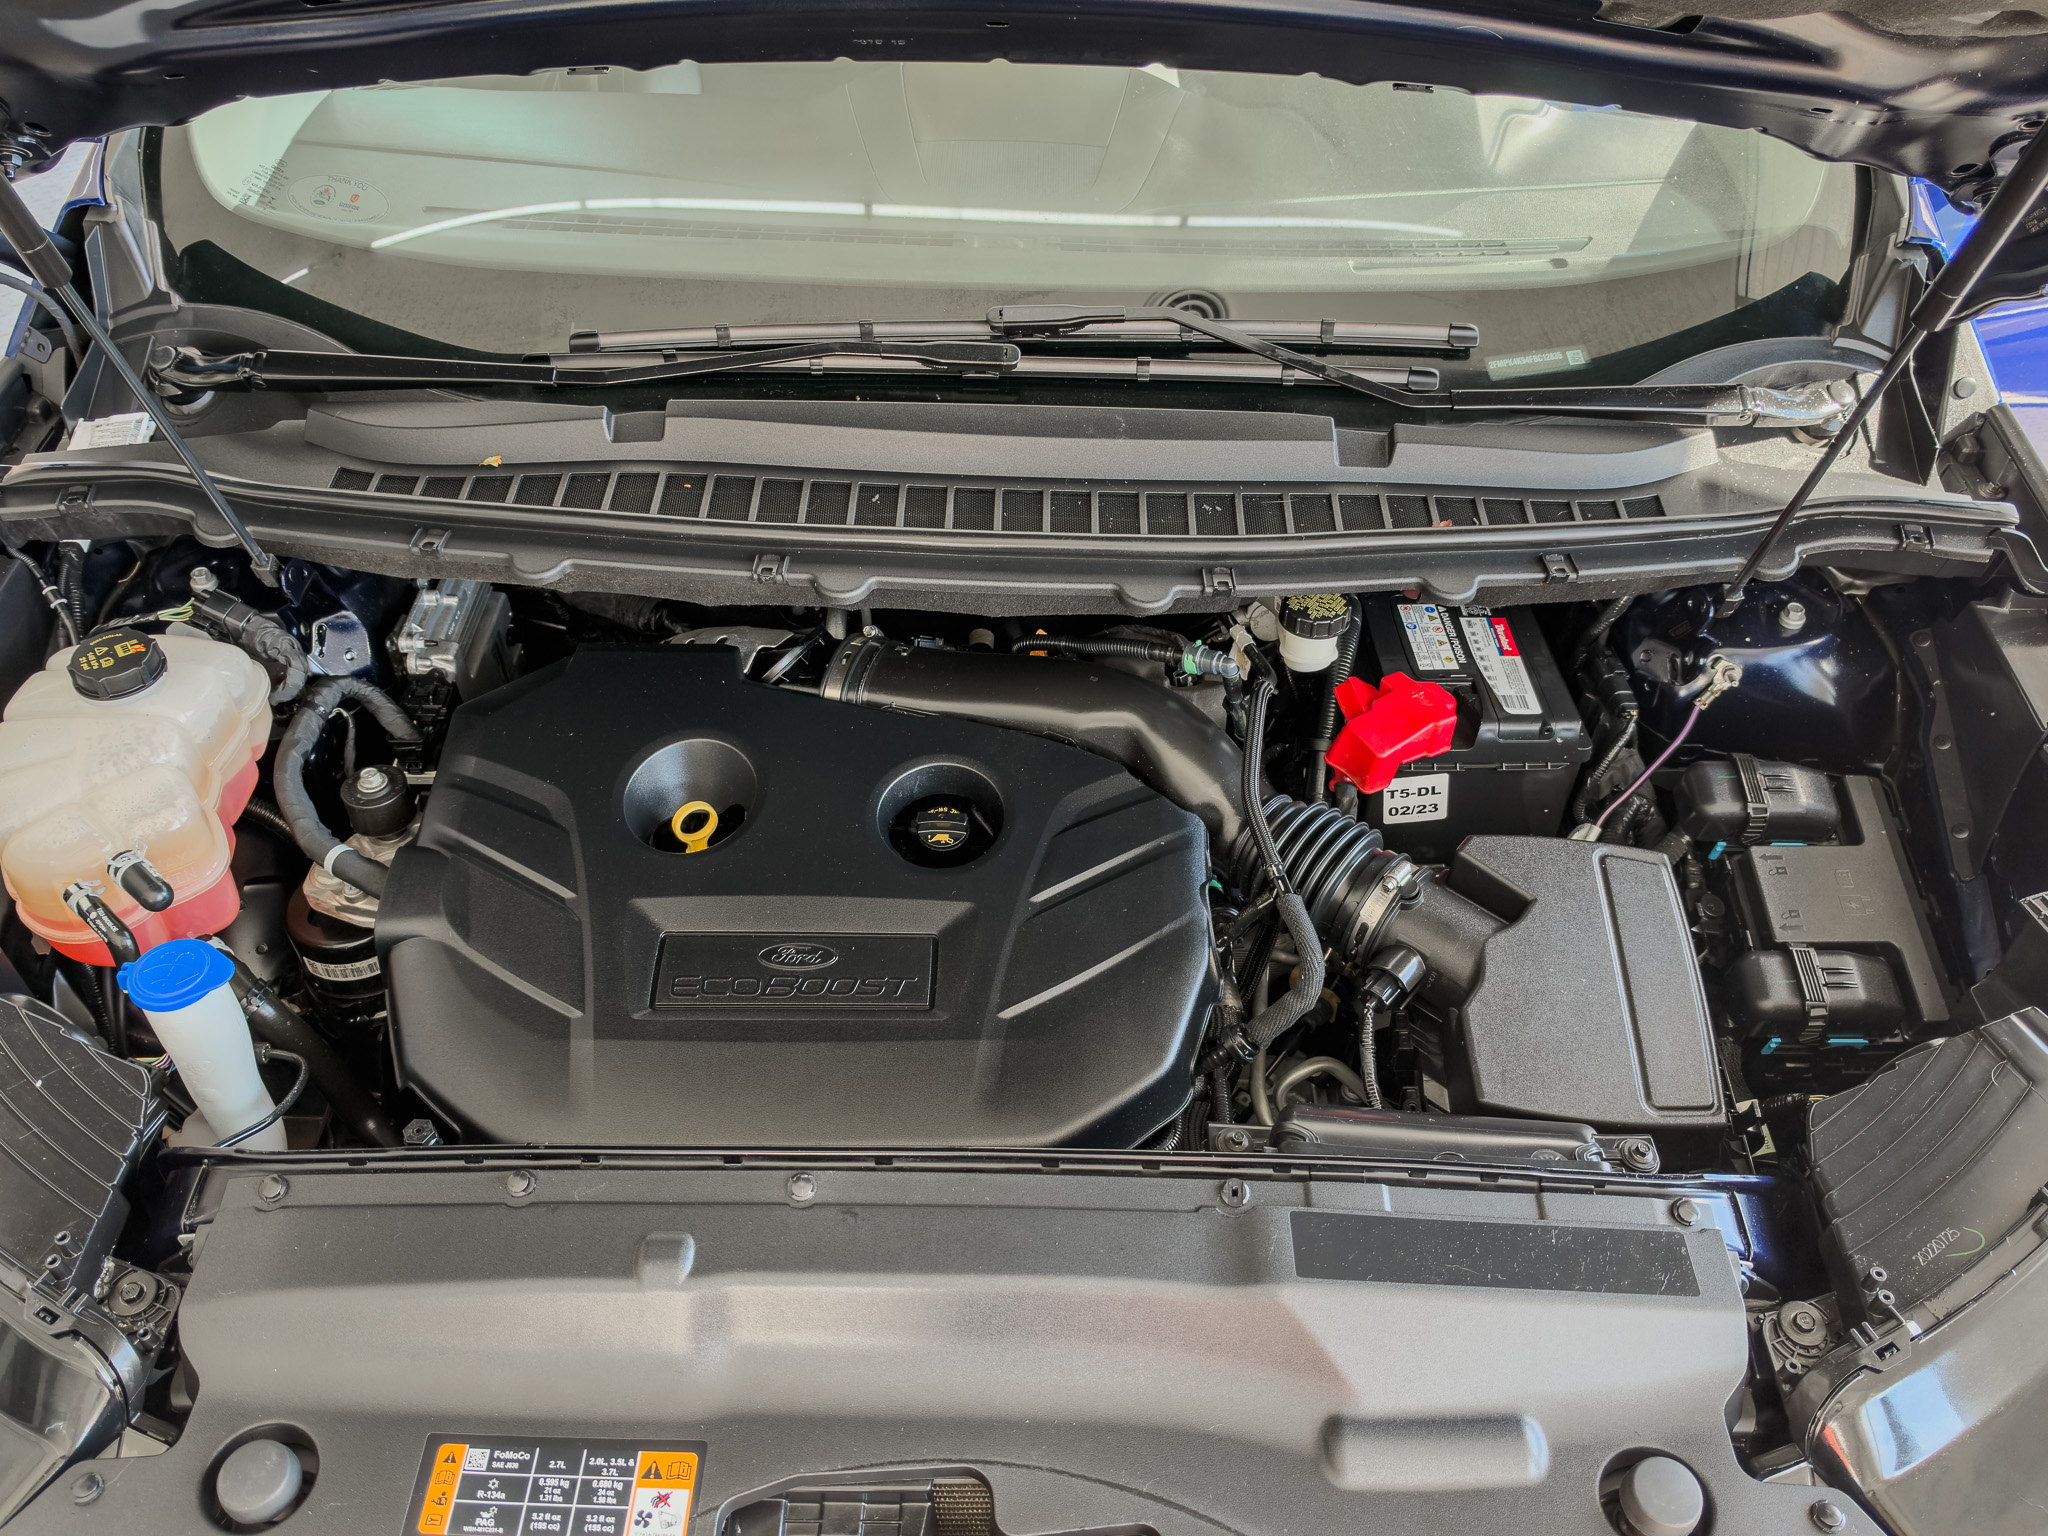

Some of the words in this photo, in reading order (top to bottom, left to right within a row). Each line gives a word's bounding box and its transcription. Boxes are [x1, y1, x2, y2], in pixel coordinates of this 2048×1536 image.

[327, 176, 351, 185] THANK
[353, 180, 368, 191] YOU
[1386, 786, 1441, 799] T5-DL
[1388, 803, 1439, 816] 02/23
[771, 945, 822, 964] Ford
[1911, 1227, 1960, 1266] 20220725
[494, 1450, 530, 1460] FoMoCo
[548, 1460, 566, 1469] 2.7L
[589, 1457, 608, 1466] 2.0L,
[609, 1458, 626, 1466] 3.5L
[628, 1458, 635, 1466] &
[601, 1468, 618, 1476] 3.7L
[538, 1477, 559, 1487] 0.595
[560, 1478, 570, 1489] kg
[592, 1480, 612, 1488] 0.680
[613, 1480, 623, 1490] kg
[476, 1490, 506, 1499] R-134a
[539, 1494, 552, 1502] 1.31
[531, 1512, 545, 1520] 5.2
[585, 1514, 599, 1522] 5.2
[474, 1518, 495, 1527] PAG
[530, 1521, 547, 1531] (155
[548, 1522, 560, 1531] cc)
[584, 1523, 601, 1533] (155
[601, 1524, 614, 1533] cc)
